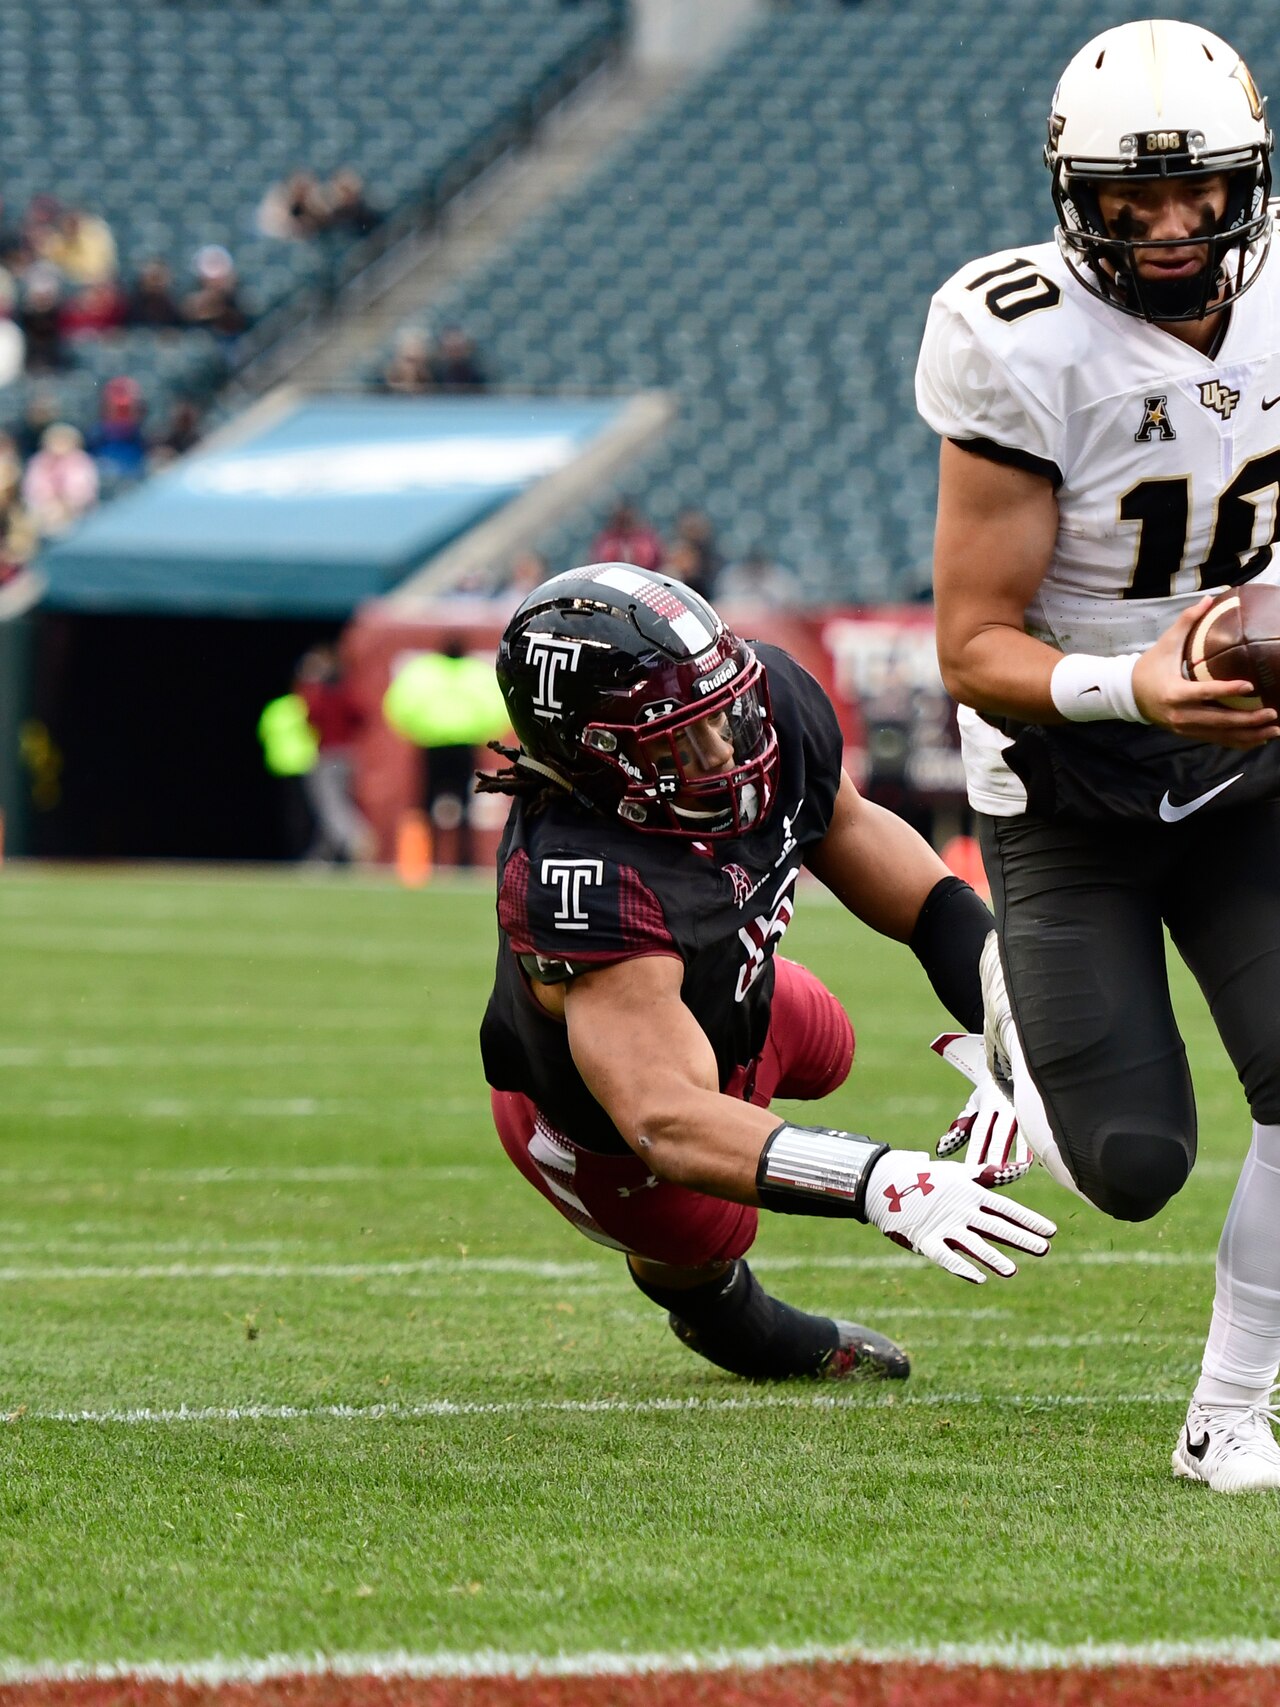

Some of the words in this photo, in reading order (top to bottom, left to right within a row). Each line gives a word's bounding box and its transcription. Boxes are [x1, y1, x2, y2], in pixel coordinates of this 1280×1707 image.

[1145, 132, 1181, 150] 808
[964, 257, 1064, 325] 10
[1134, 395, 1176, 442] A
[1196, 379, 1240, 420] UCF
[525, 638, 582, 719] T
[699, 661, 738, 695] Riddell
[541, 859, 603, 930] T
